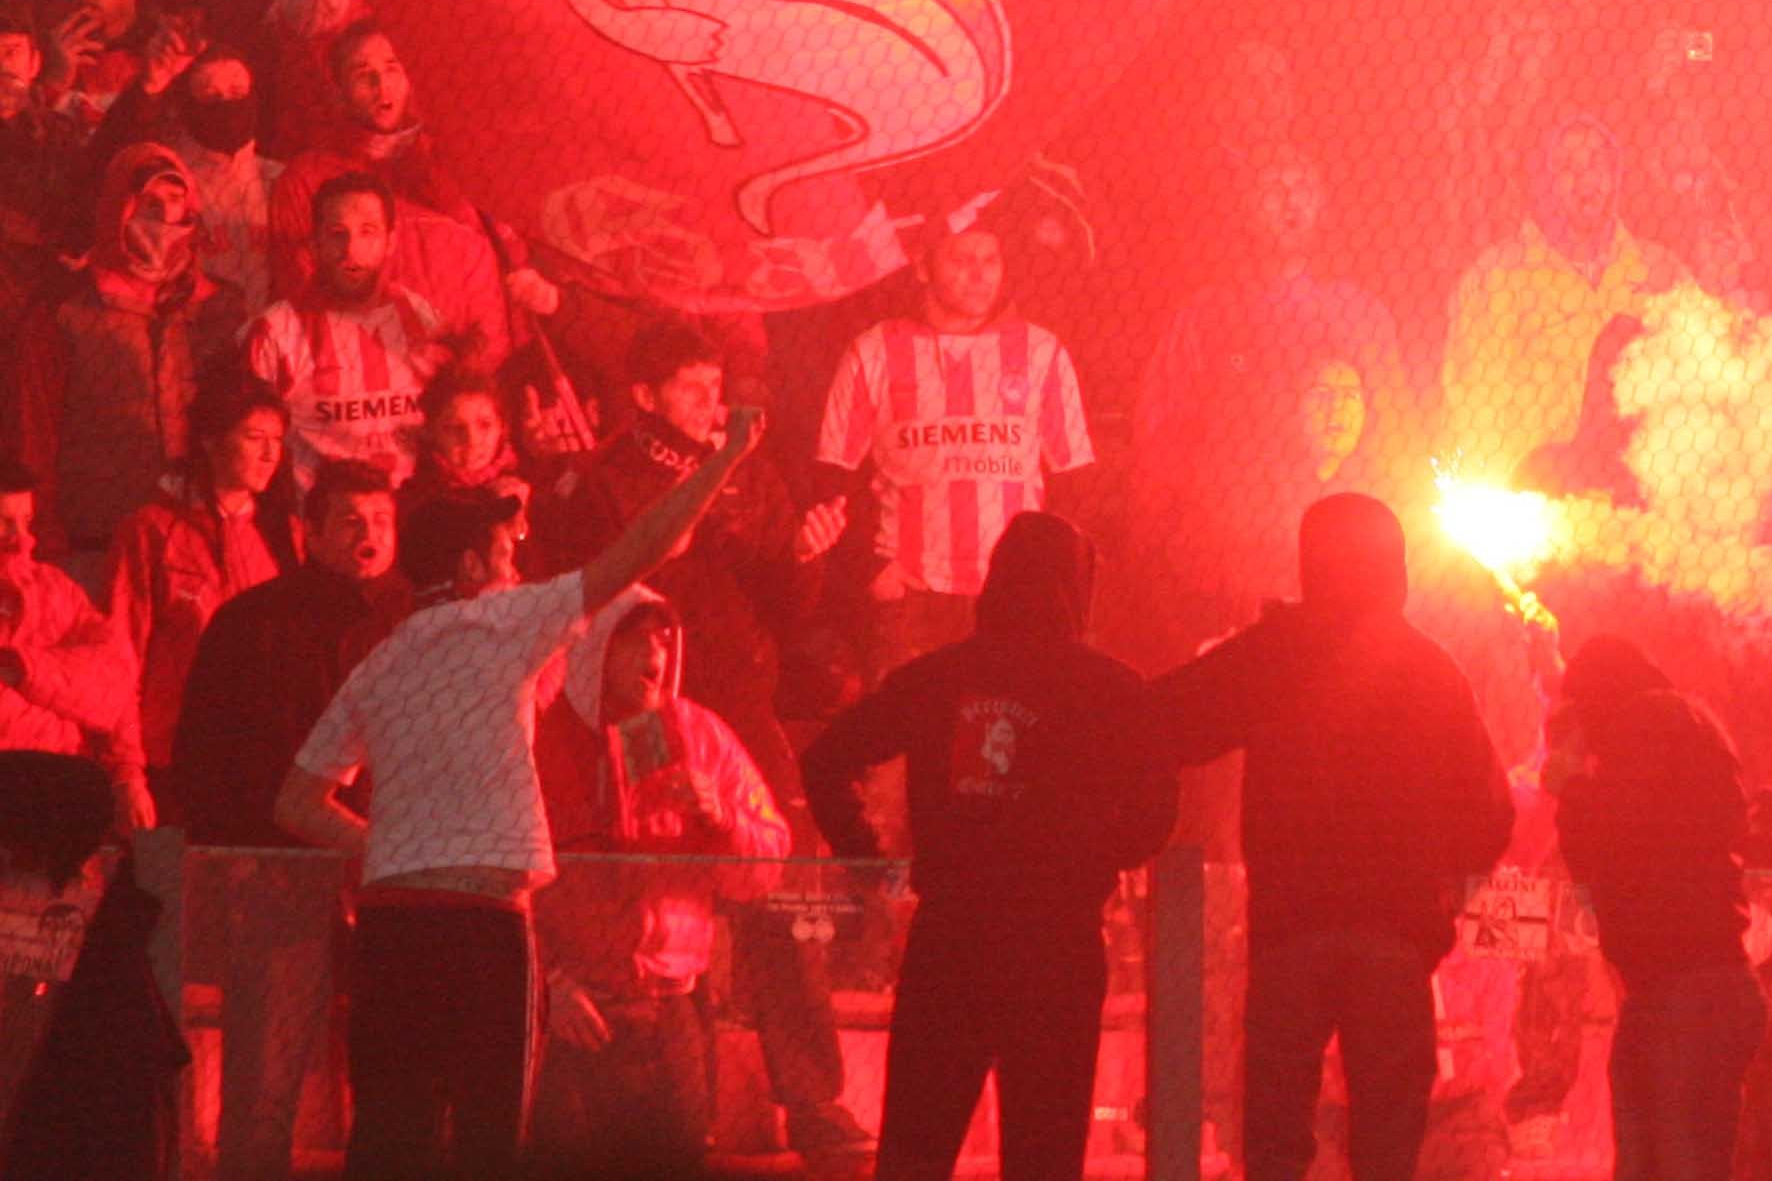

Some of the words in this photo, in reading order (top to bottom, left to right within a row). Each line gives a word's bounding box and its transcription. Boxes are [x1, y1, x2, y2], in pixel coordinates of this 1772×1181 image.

[315, 395, 420, 424] SIEMEN
[897, 423, 1022, 449] SIEMENS
[944, 454, 1023, 475] mobile
